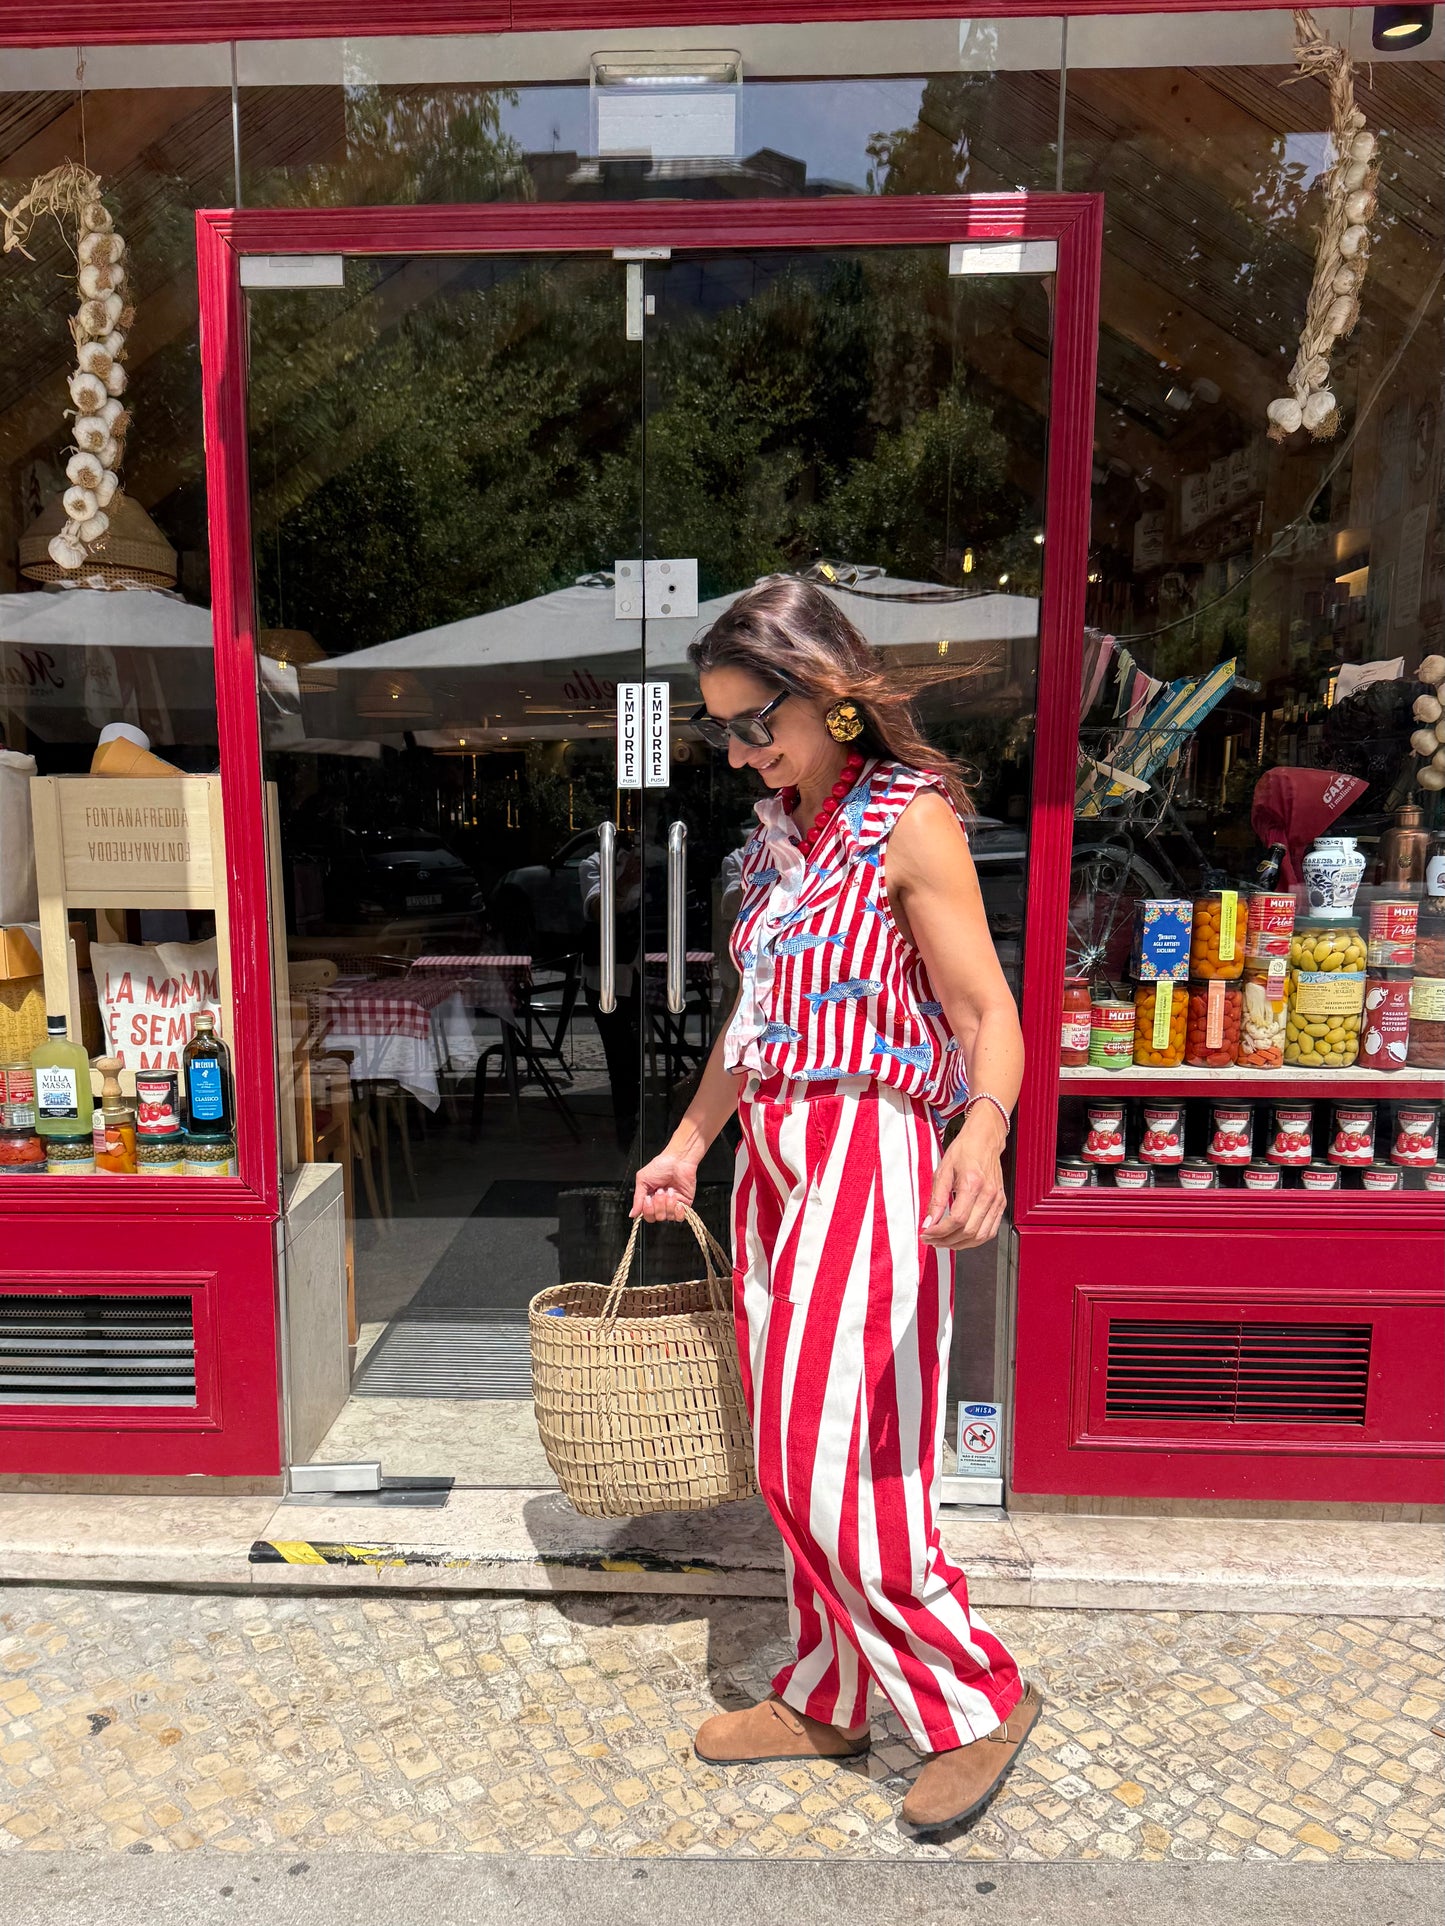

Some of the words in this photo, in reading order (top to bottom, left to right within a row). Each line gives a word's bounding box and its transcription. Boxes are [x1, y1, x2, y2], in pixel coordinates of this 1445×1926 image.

[624, 688, 635, 777] EMPURRE
[652, 686, 662, 776] EMPURRE
[1334, 786, 1352, 805] mulino
[86, 807, 190, 828] FONTANAFREDDA
[88, 842, 192, 862] FONTANAFREDDA
[105, 972, 134, 1004] LA
[145, 968, 218, 1008] MAMM
[110, 1006, 120, 1045] È
[130, 1007, 223, 1046] SEMPR
